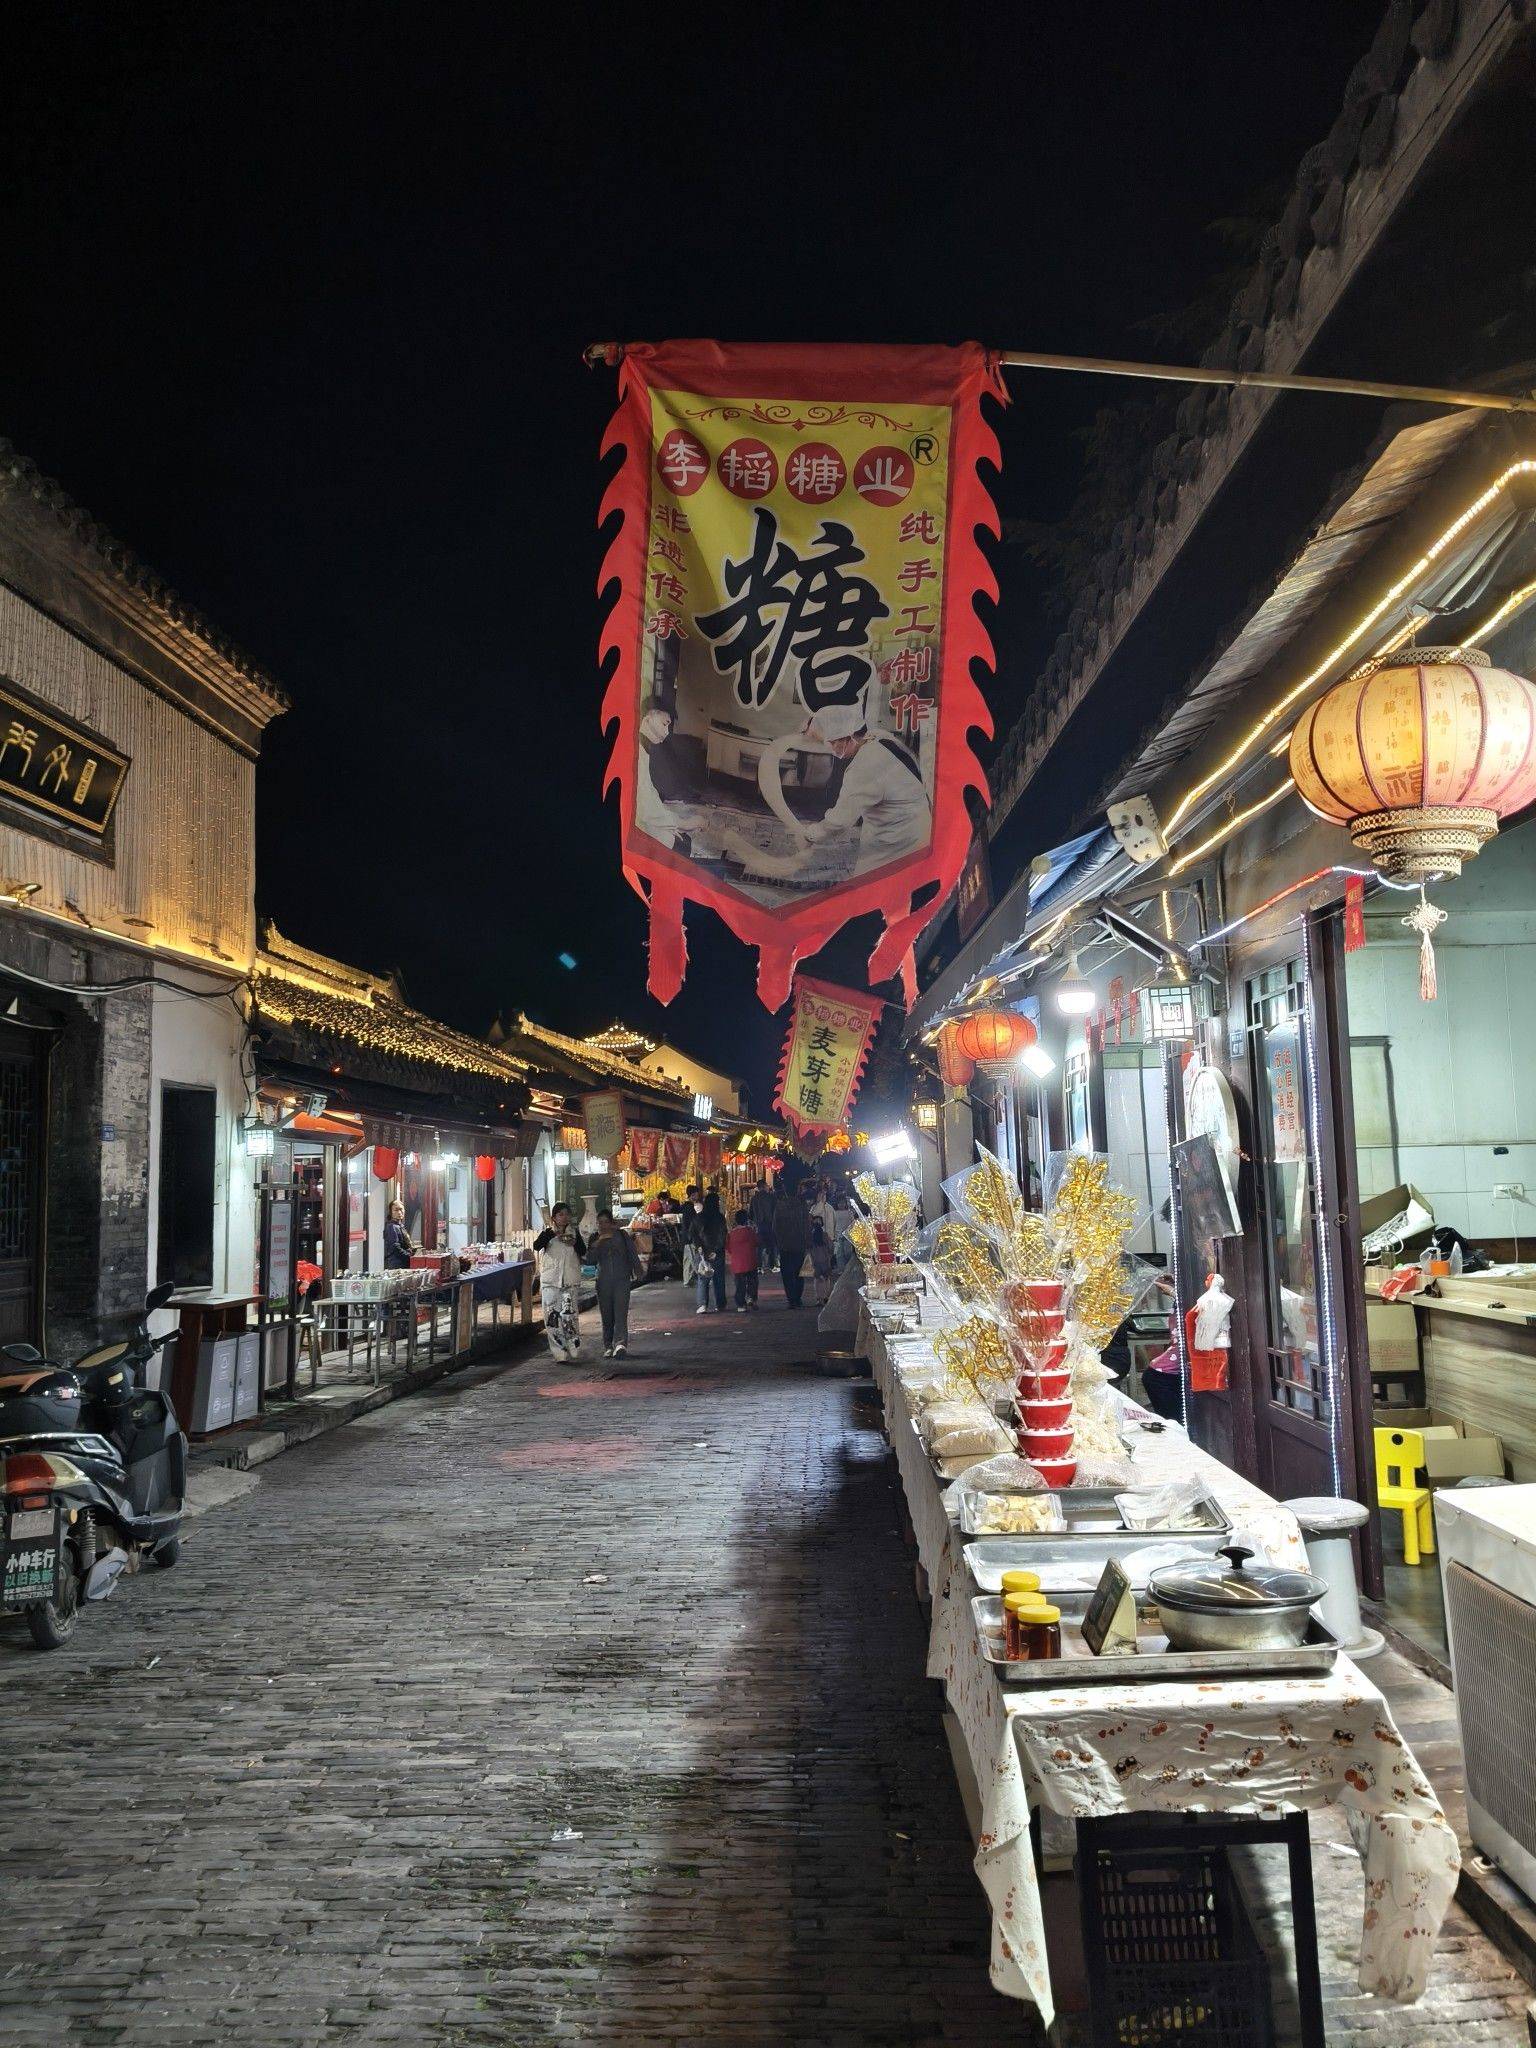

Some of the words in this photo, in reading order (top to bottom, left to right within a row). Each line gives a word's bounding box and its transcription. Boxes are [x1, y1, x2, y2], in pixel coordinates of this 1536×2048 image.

[661, 438, 911, 498] 李韬糖业
[646, 503, 692, 640] 非遗传承
[694, 507, 890, 713] 糖
[889, 510, 940, 733] 纯手工制作
[800, 1026, 838, 1116] 麦芽糖
